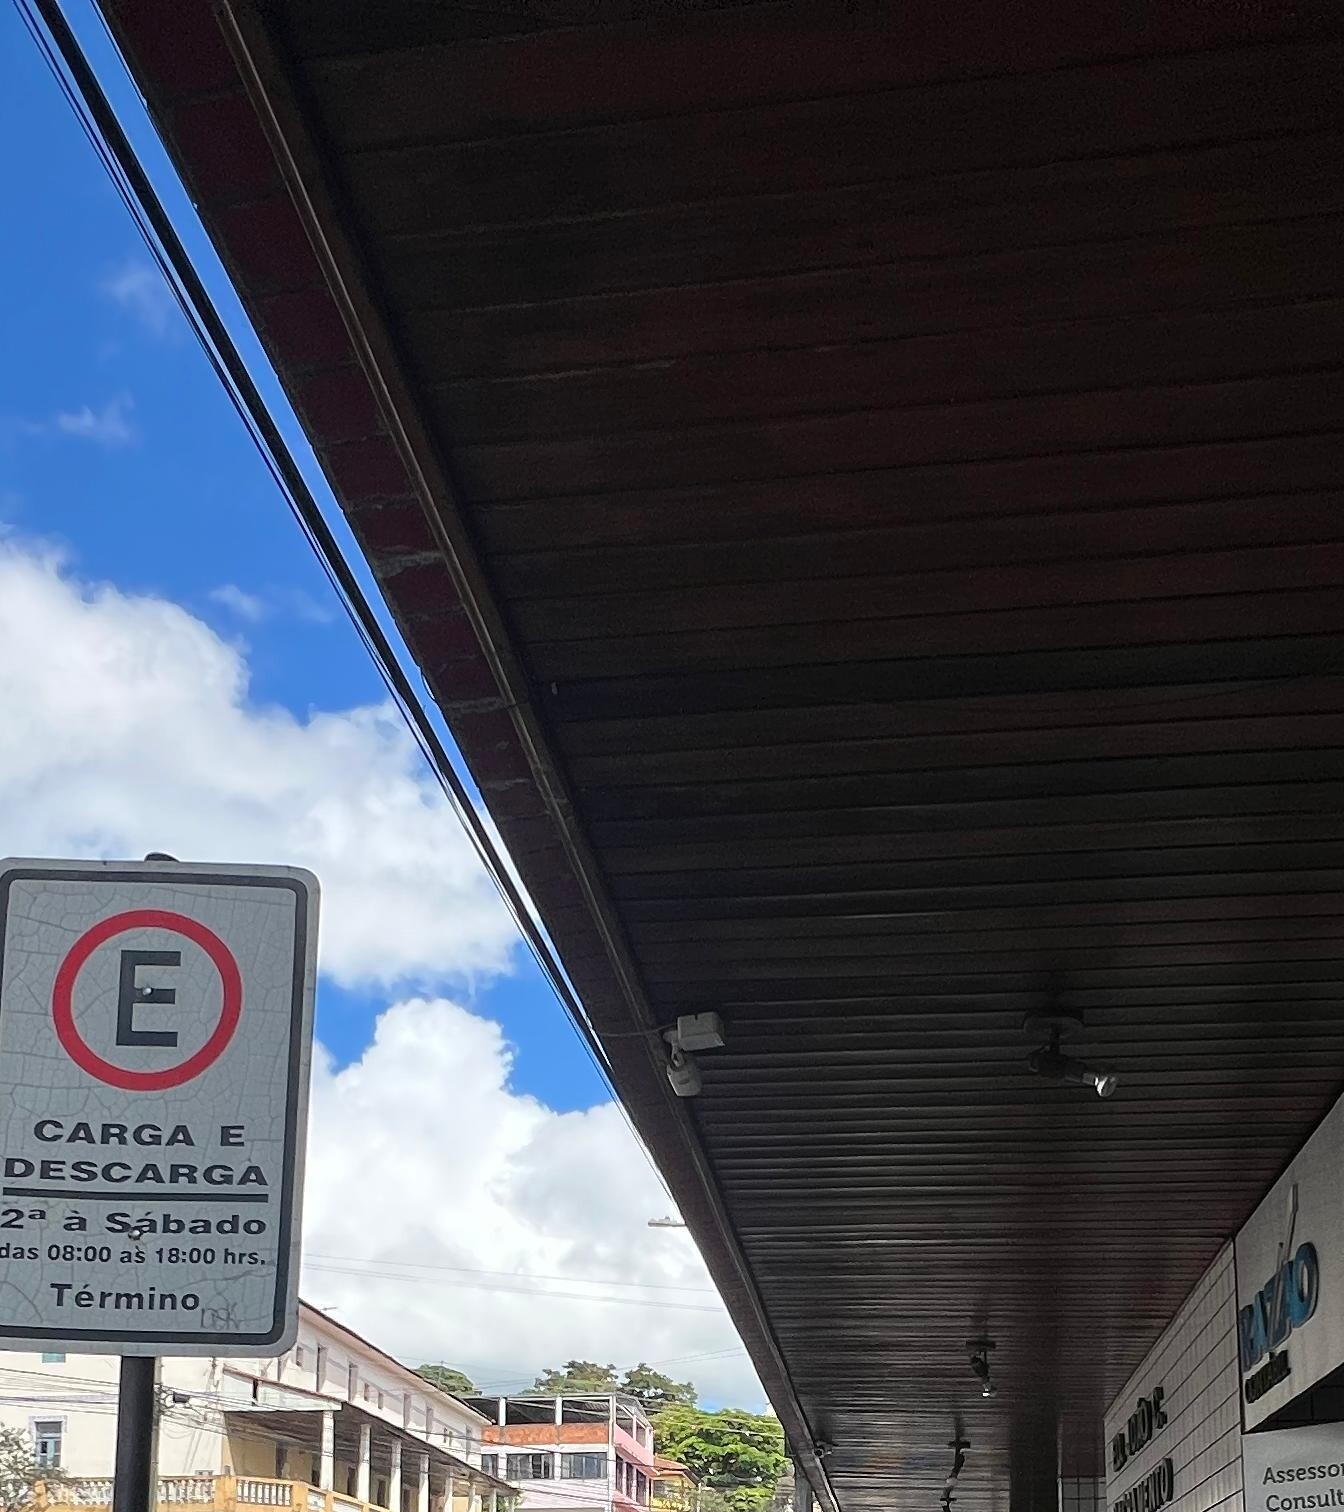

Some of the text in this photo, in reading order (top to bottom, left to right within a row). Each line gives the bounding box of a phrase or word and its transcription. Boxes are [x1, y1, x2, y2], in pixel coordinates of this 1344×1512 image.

[116, 950, 181, 1046] E
[34, 1119, 245, 1147] CARGA E
[4, 1158, 269, 1186] DESCARGA
[63, 1210, 87, 1232] à
[105, 1211, 267, 1236] Sábado
[47, 1244, 112, 1263] 08:00
[156, 1248, 216, 1265] 18:00
[223, 1248, 267, 1266] hrs.
[50, 1282, 201, 1311] Término
